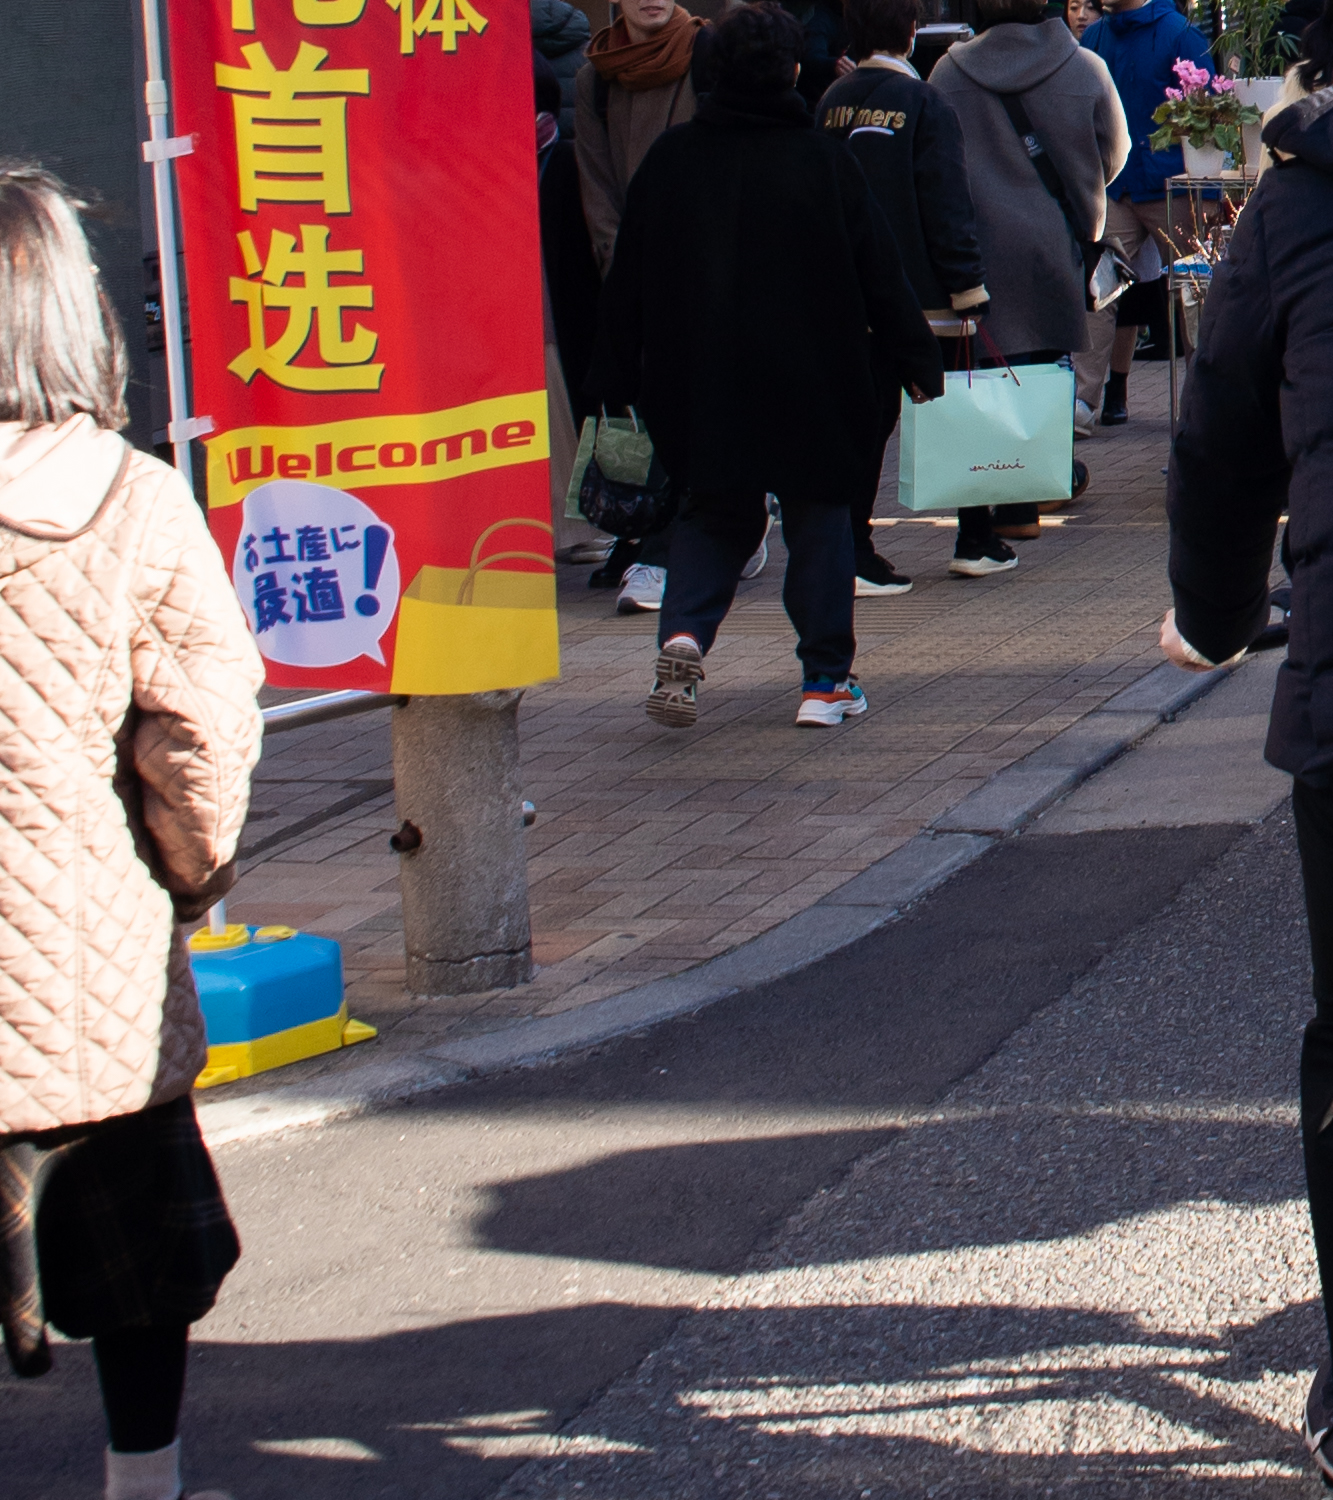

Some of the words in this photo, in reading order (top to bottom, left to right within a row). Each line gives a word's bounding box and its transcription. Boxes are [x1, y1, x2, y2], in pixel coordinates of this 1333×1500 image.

[226, 419, 537, 486] Welcome
[243, 524, 362, 574] お土産に
